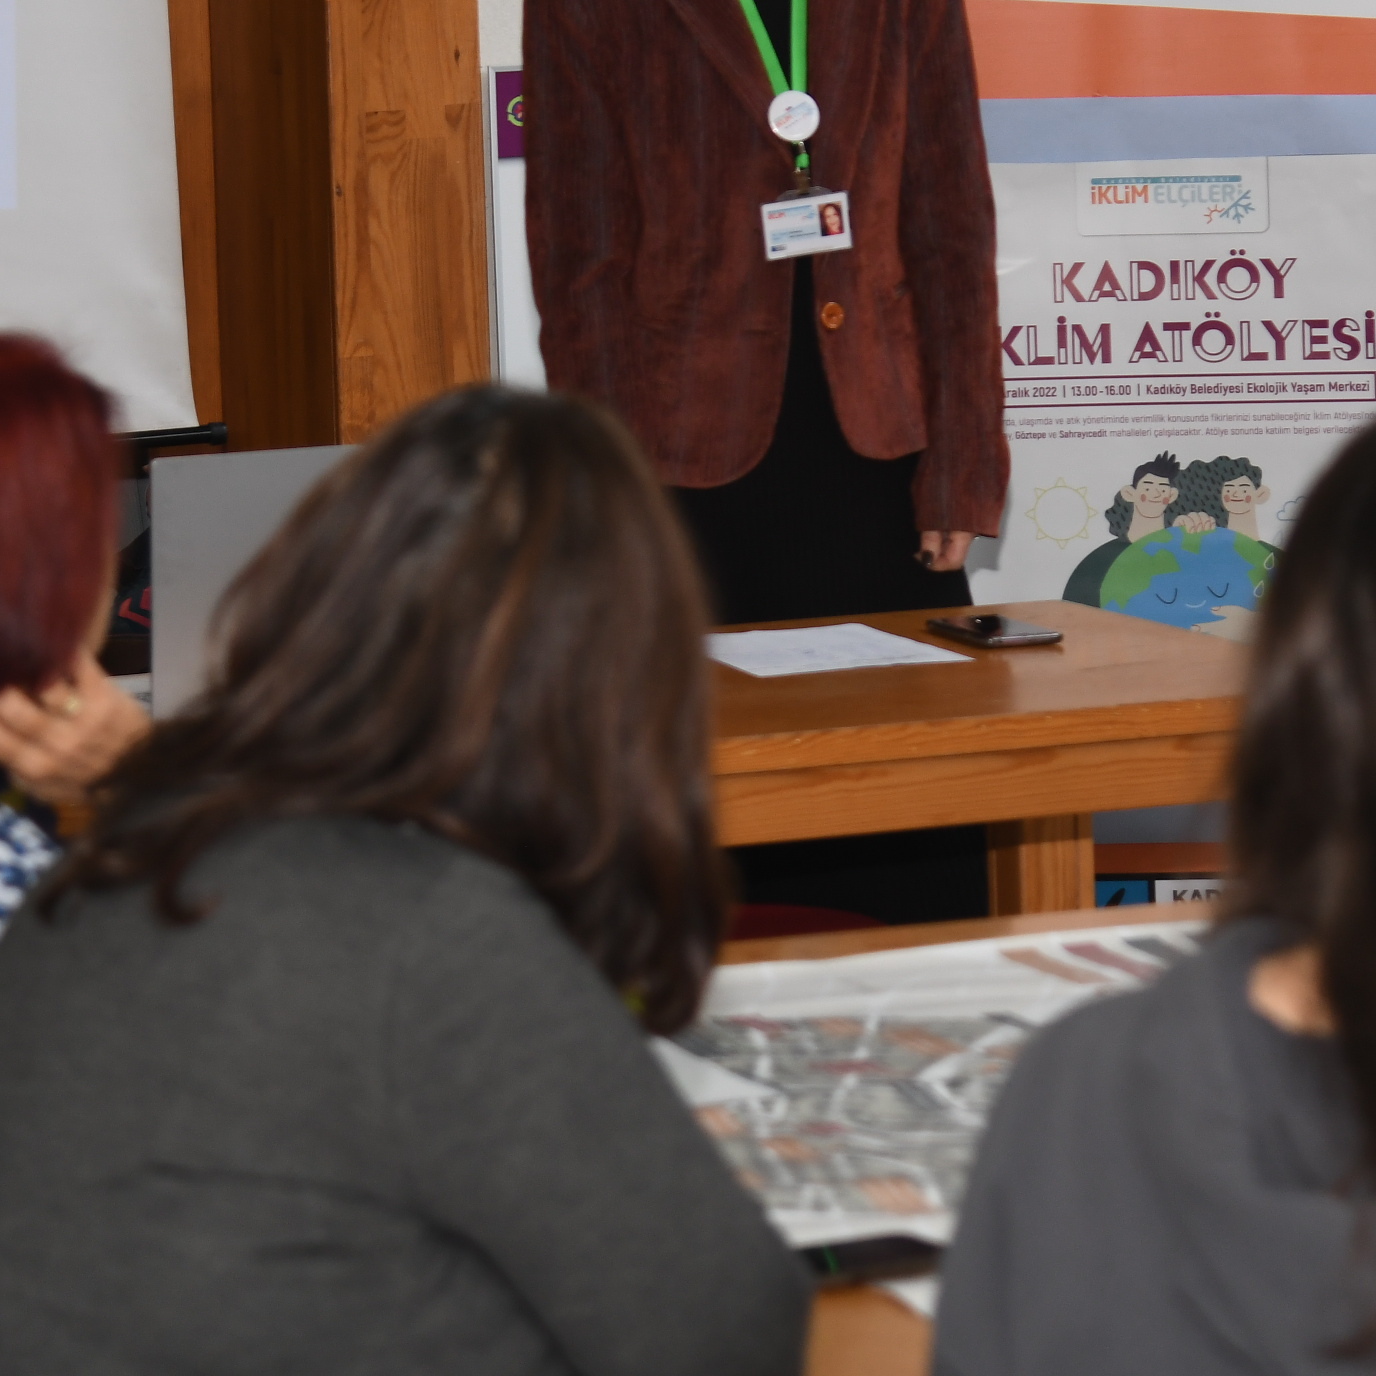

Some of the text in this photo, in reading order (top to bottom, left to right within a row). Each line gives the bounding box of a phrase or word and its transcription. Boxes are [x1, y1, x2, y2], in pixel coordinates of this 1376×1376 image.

[1053, 248, 1298, 304] KADIKÖY
[1000, 315, 1112, 366] KLİM
[1032, 386, 1057, 398] 2022
[1146, 384, 1188, 397] Kadıköy
[1190, 382, 1244, 396] Belediyesi
[1247, 381, 1289, 395] Ekolojik
[1291, 382, 1326, 395] Yaşam
[1328, 380, 1370, 392] Merkezi
[1015, 431, 1046, 440] Göztepe
